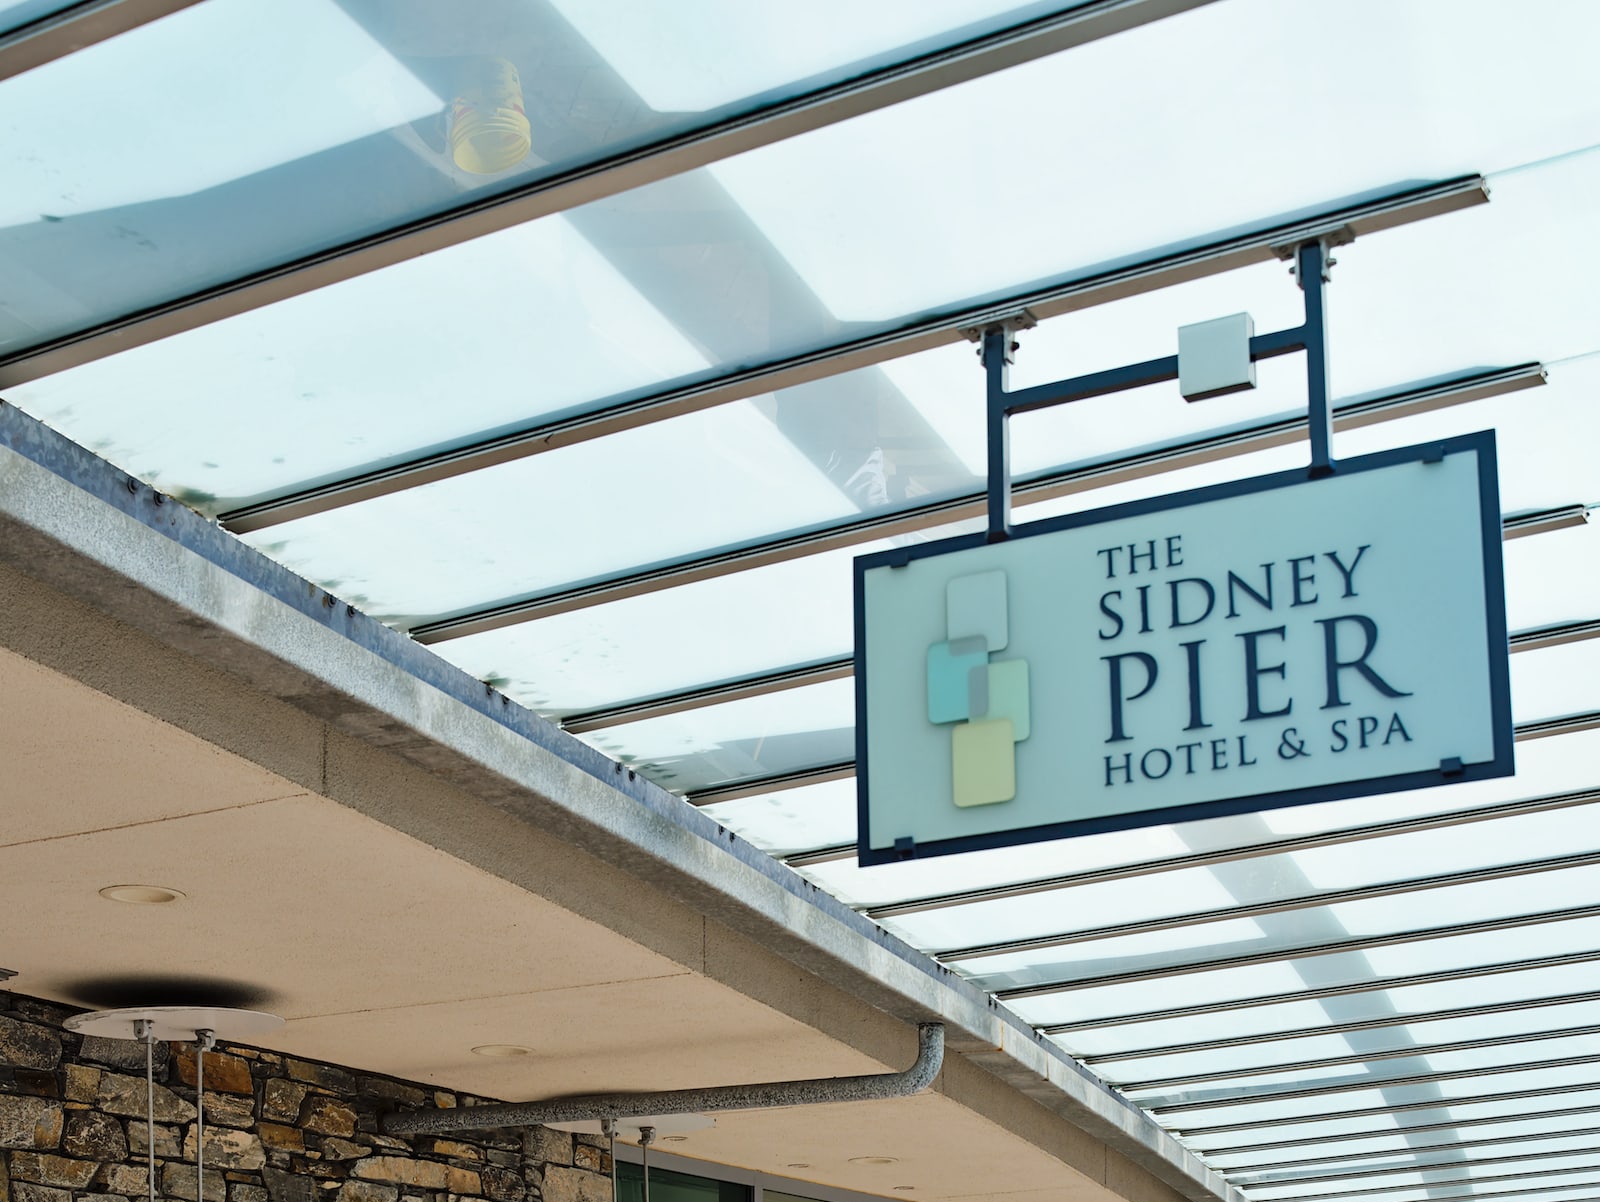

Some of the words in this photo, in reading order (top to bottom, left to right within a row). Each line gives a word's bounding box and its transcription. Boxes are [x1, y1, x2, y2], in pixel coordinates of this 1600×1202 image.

[1097, 535, 1184, 579] THE
[1098, 544, 1371, 641] SIDNEY
[1100, 614, 1414, 744] PIER
[1103, 735, 1257, 787] HOTEL
[1278, 727, 1311, 761] &
[1330, 712, 1413, 753] SPA
